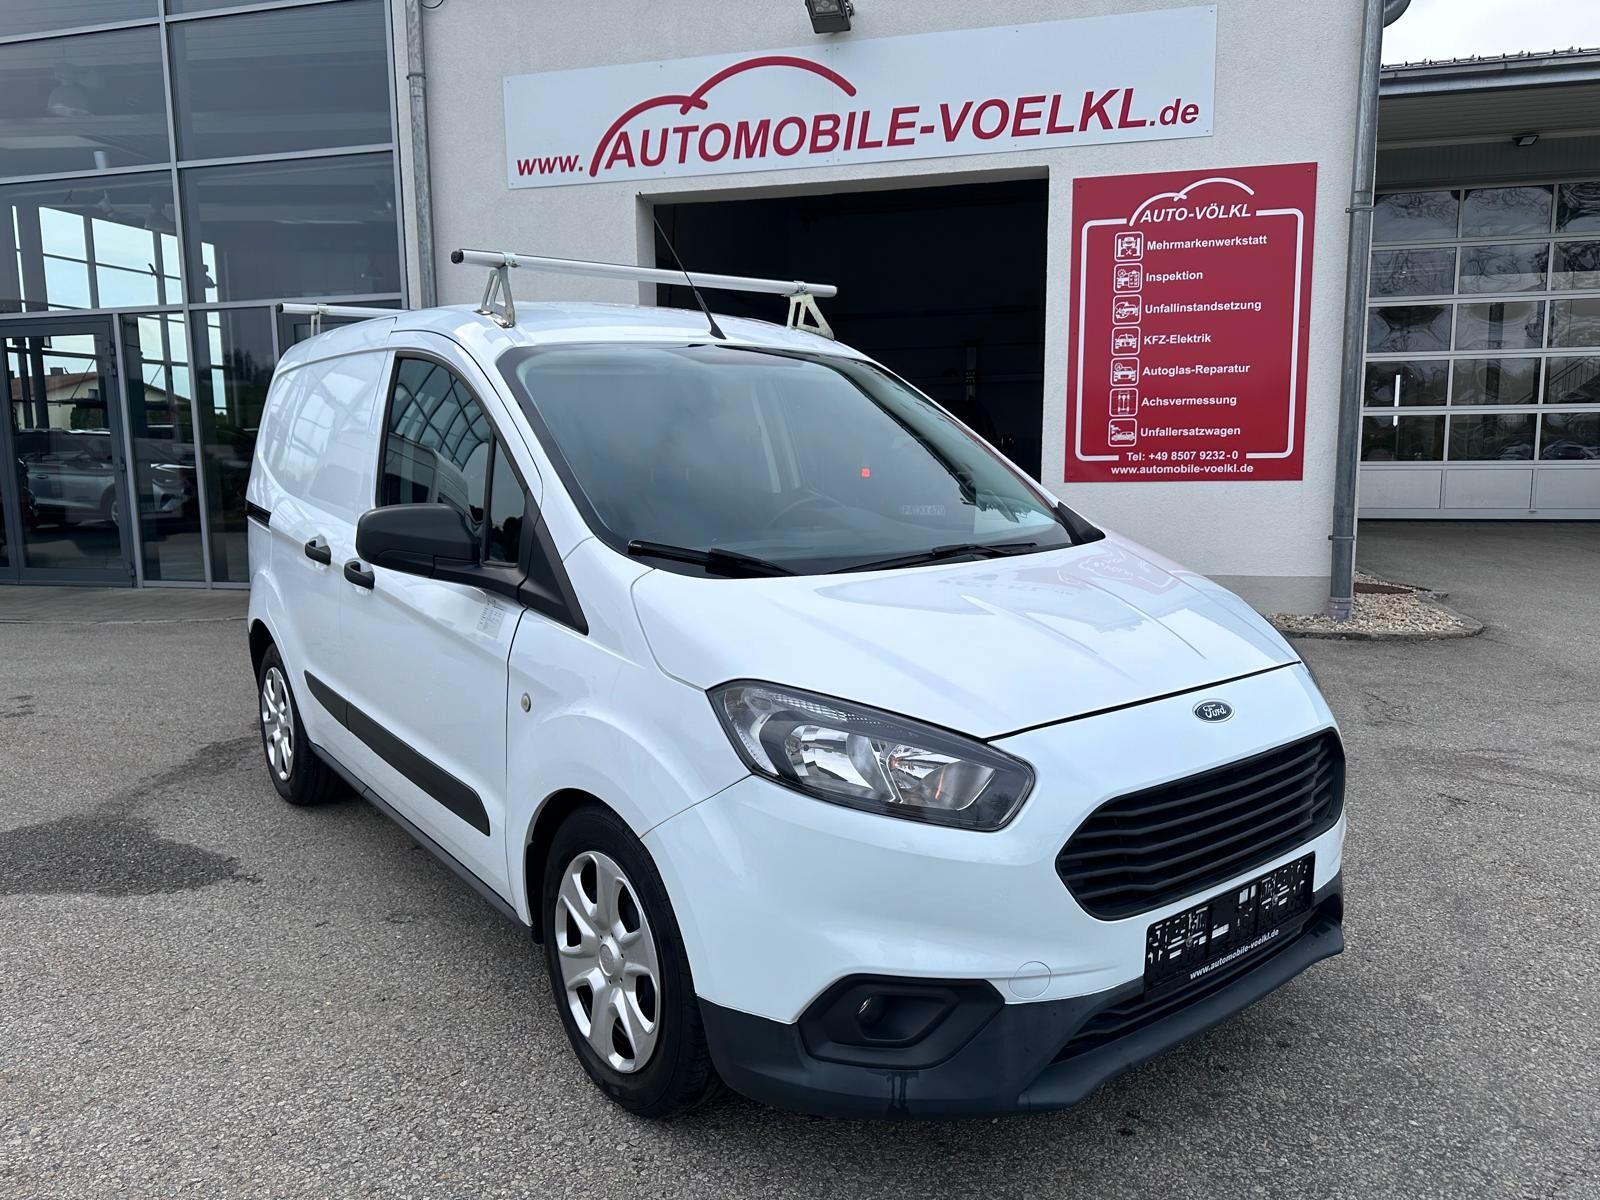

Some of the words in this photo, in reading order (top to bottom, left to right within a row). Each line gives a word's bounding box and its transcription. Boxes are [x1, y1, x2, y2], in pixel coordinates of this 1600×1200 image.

[1139, 202, 1252, 224] AUTO-VÖLKL
[1146, 234, 1268, 251] Mehrmarkenwerkstatt
[1145, 270, 1204, 284] Inspektion
[1144, 299, 1263, 315] Unfallinstandsetzung
[1143, 332, 1212, 346] KFZ-Elektrik
[1142, 363, 1251, 379] Autoglas-Reparatur
[1141, 395, 1238, 410] Achsvermessung
[1140, 426, 1241, 441] Unfallersatzwagen
[1126, 451, 1146, 462] Tel:
[1148, 451, 1169, 461] +49
[1170, 451, 1197, 461] 8507
[1110, 462, 1255, 475] www.automobile-voelkl.de
[1203, 703, 1228, 719] Ford
[1189, 928, 1280, 980] www.automobile-voelkl.de
